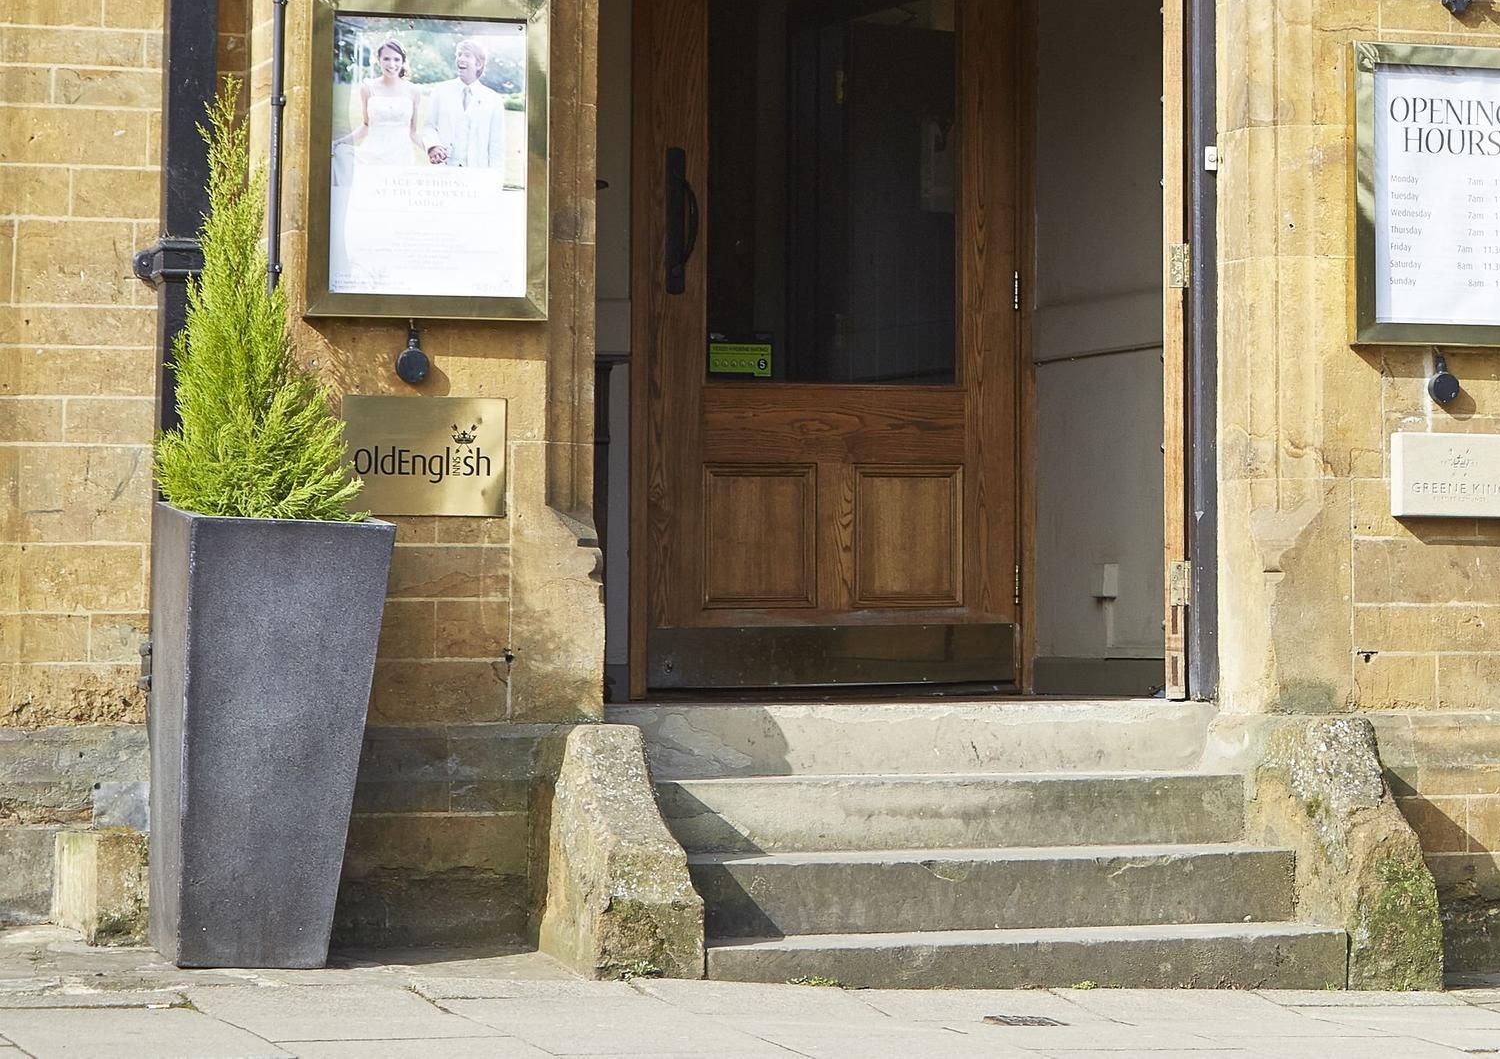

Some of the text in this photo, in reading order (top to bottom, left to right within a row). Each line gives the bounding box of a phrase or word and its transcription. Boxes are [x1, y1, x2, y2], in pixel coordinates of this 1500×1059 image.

[1390, 174, 1419, 186] Monday
[1390, 191, 1419, 202] Tuesday
[1390, 208, 1432, 220] Wednesday
[1390, 225, 1422, 236] Thursday
[1390, 242, 1412, 253] Friday
[1389, 259, 1422, 270] Saturday
[1389, 276, 1416, 286] Sunday
[452, 456, 462, 476] INNS
[1411, 482, 1467, 494] GREENE
